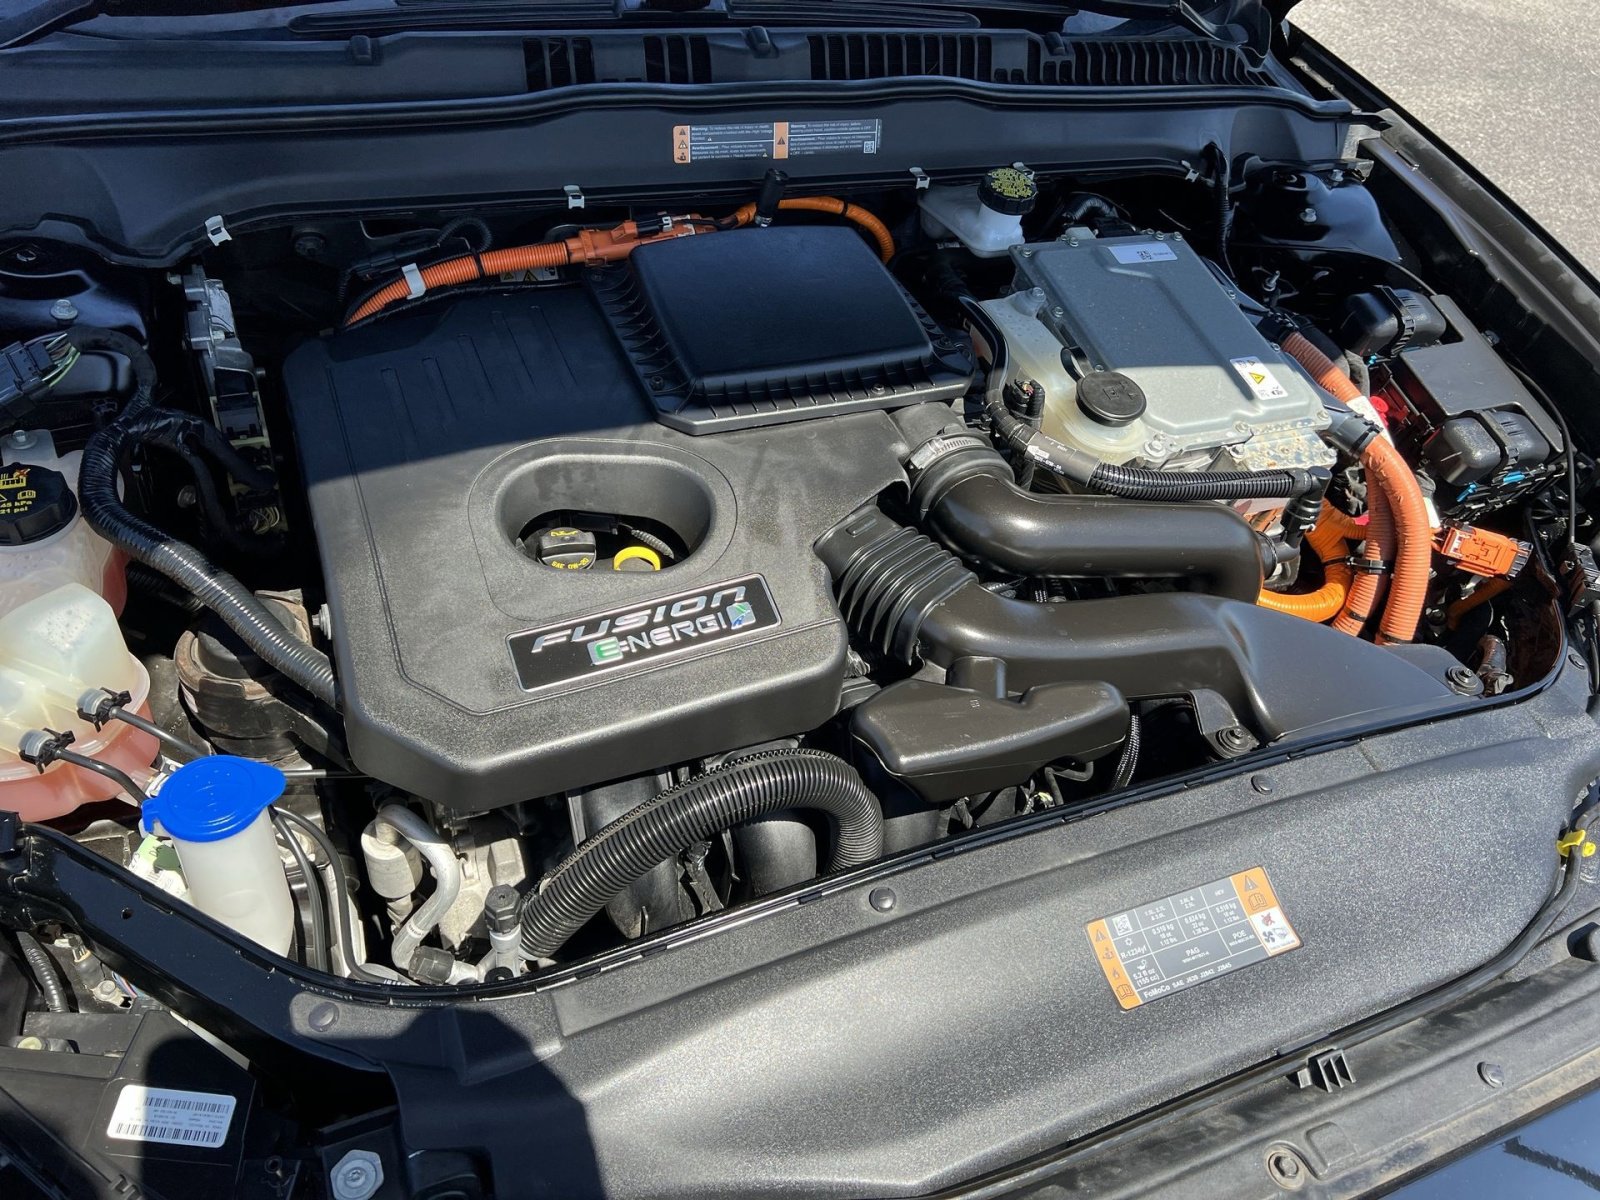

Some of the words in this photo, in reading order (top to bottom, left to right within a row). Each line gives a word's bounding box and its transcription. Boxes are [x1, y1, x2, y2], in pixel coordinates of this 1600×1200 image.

[552, 560, 565, 569] SAE
[530, 585, 747, 654] FUSION
[1232, 930, 1247, 940] POE
[1120, 945, 1147, 959] R-1234yf
[1186, 946, 1200, 956] PAG
[1137, 976, 1150, 987] (155
[1150, 973, 1160, 981] cc)
[1144, 985, 1170, 998] FoMoCo
[1172, 979, 1185, 988] SAE
